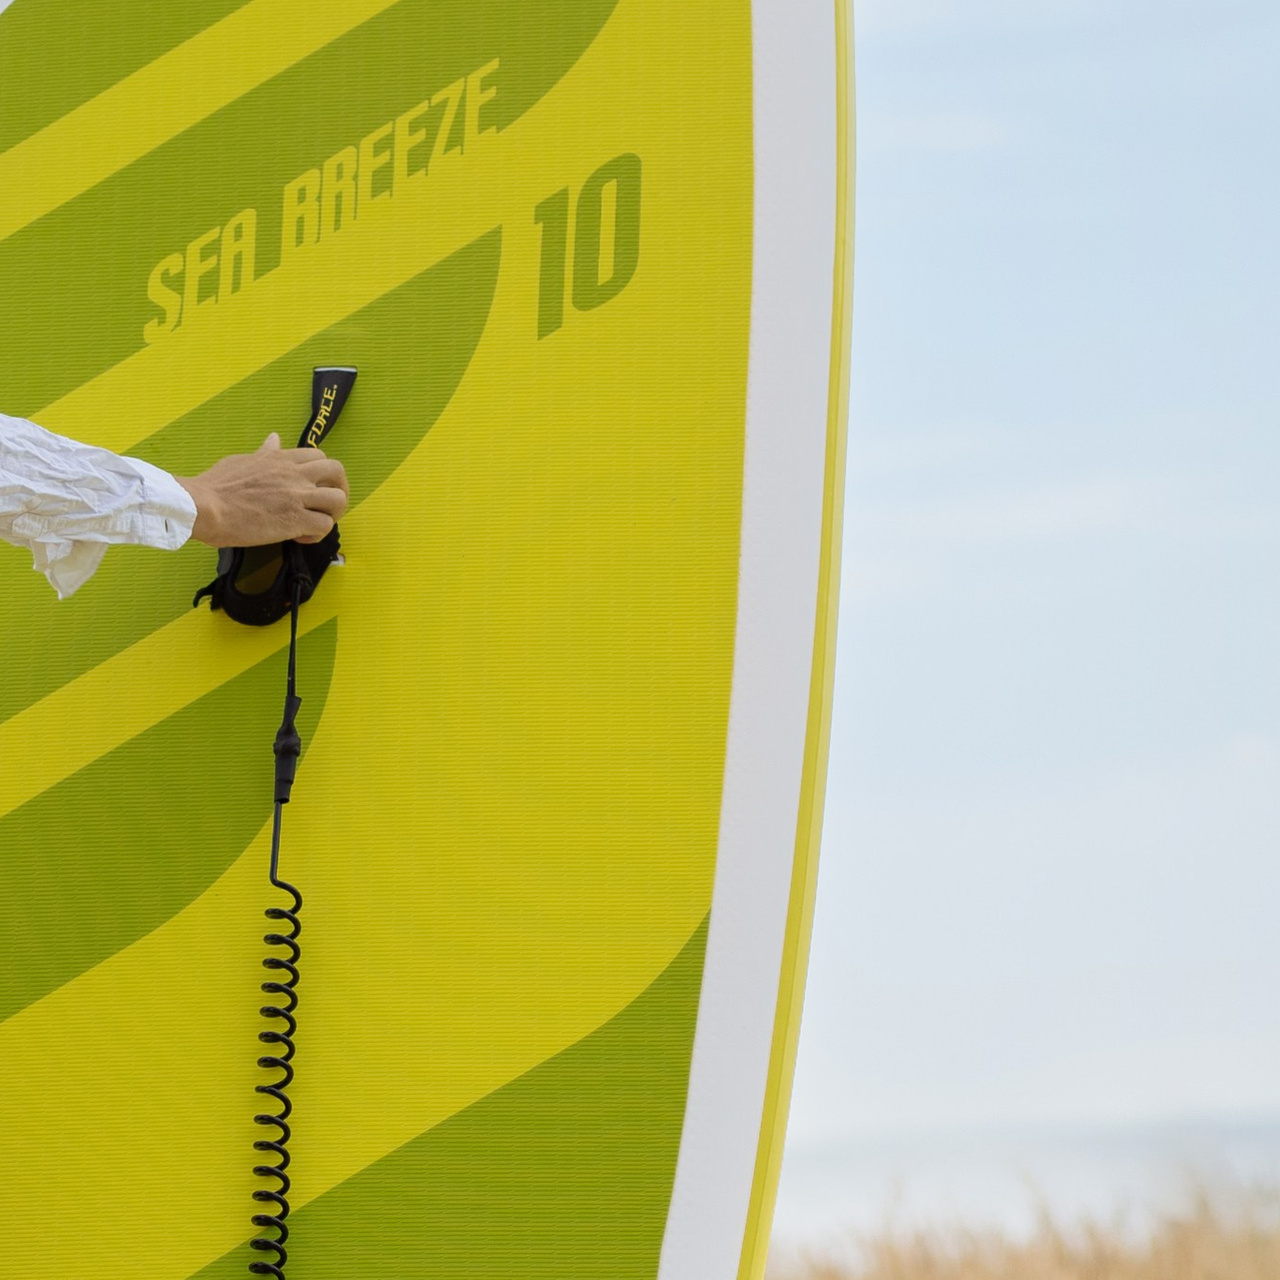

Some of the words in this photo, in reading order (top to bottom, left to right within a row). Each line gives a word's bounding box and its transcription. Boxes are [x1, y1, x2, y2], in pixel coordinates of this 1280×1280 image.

[143, 207, 257, 345] SEA
[281, 57, 500, 266] BREEZE
[533, 152, 643, 342] 10
